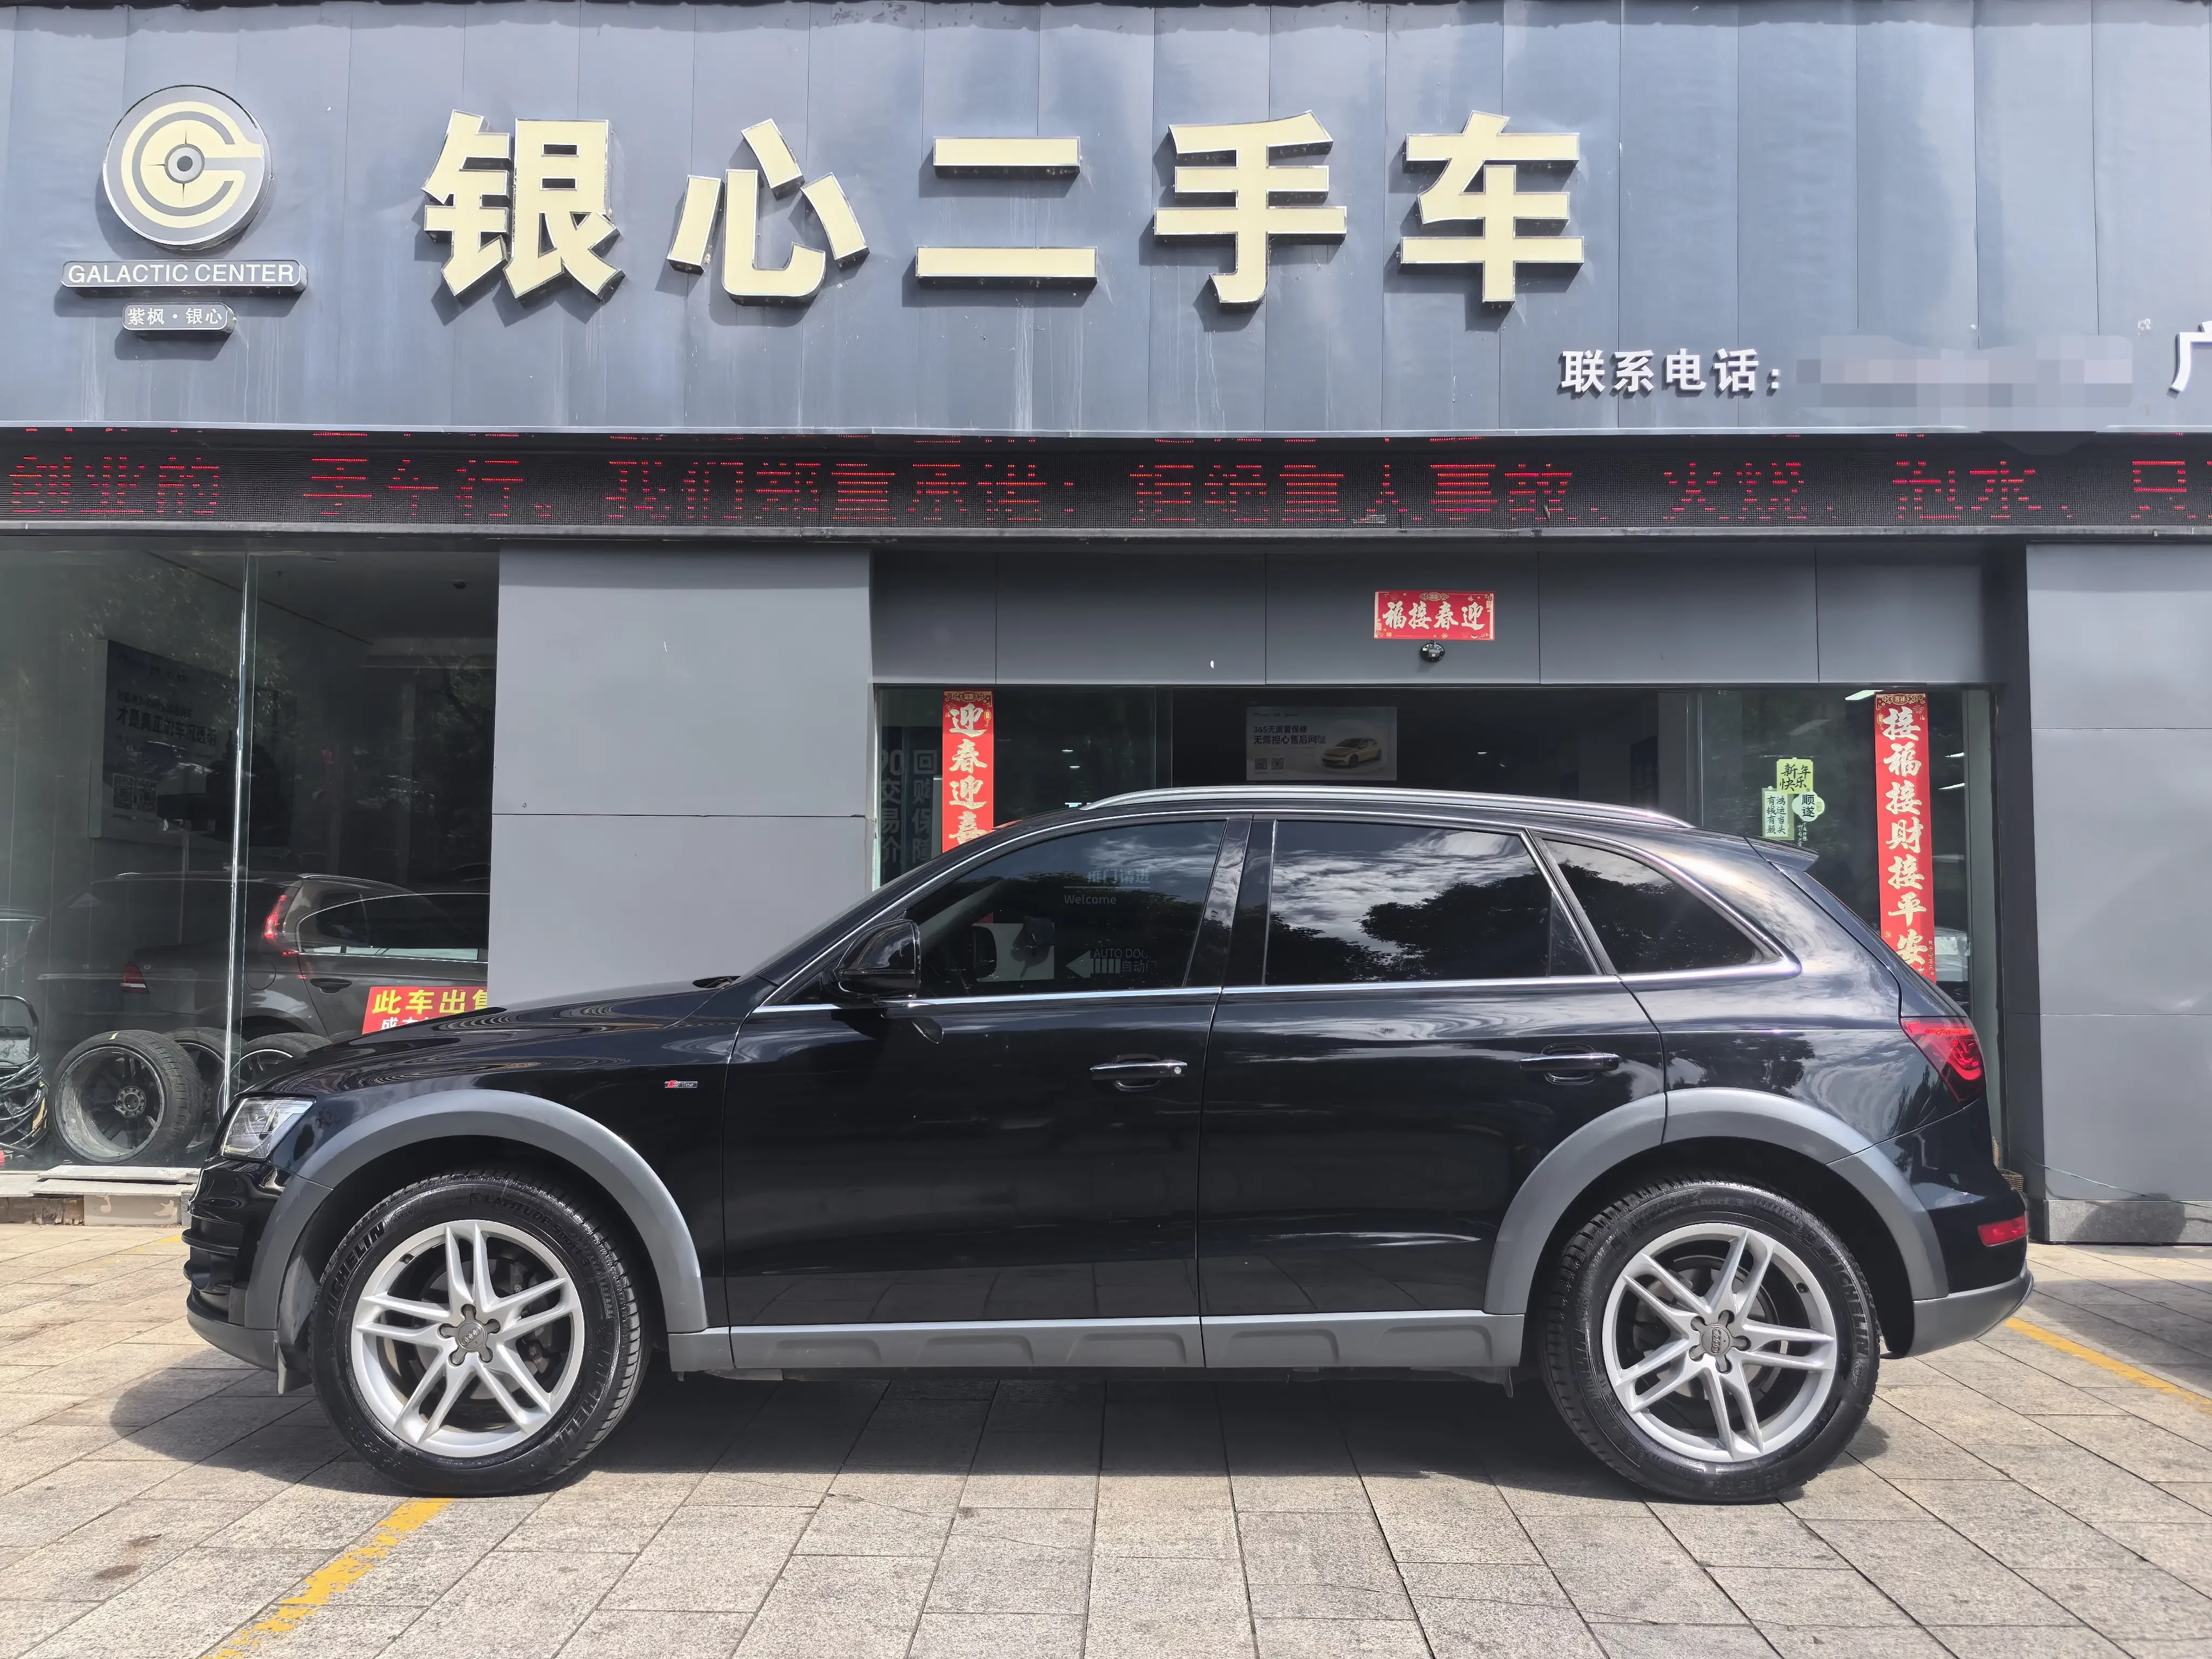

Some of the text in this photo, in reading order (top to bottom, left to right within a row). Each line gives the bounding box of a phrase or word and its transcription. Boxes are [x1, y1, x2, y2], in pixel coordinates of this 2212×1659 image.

[423, 110, 1584, 305] 银心二手车
[68, 264, 294, 284] GALACTIC CENTER
[1063, 894, 1117, 905] Welcome
[1093, 948, 1151, 959] AUTO DOO
[1122, 960, 1157, 973] 自动门
